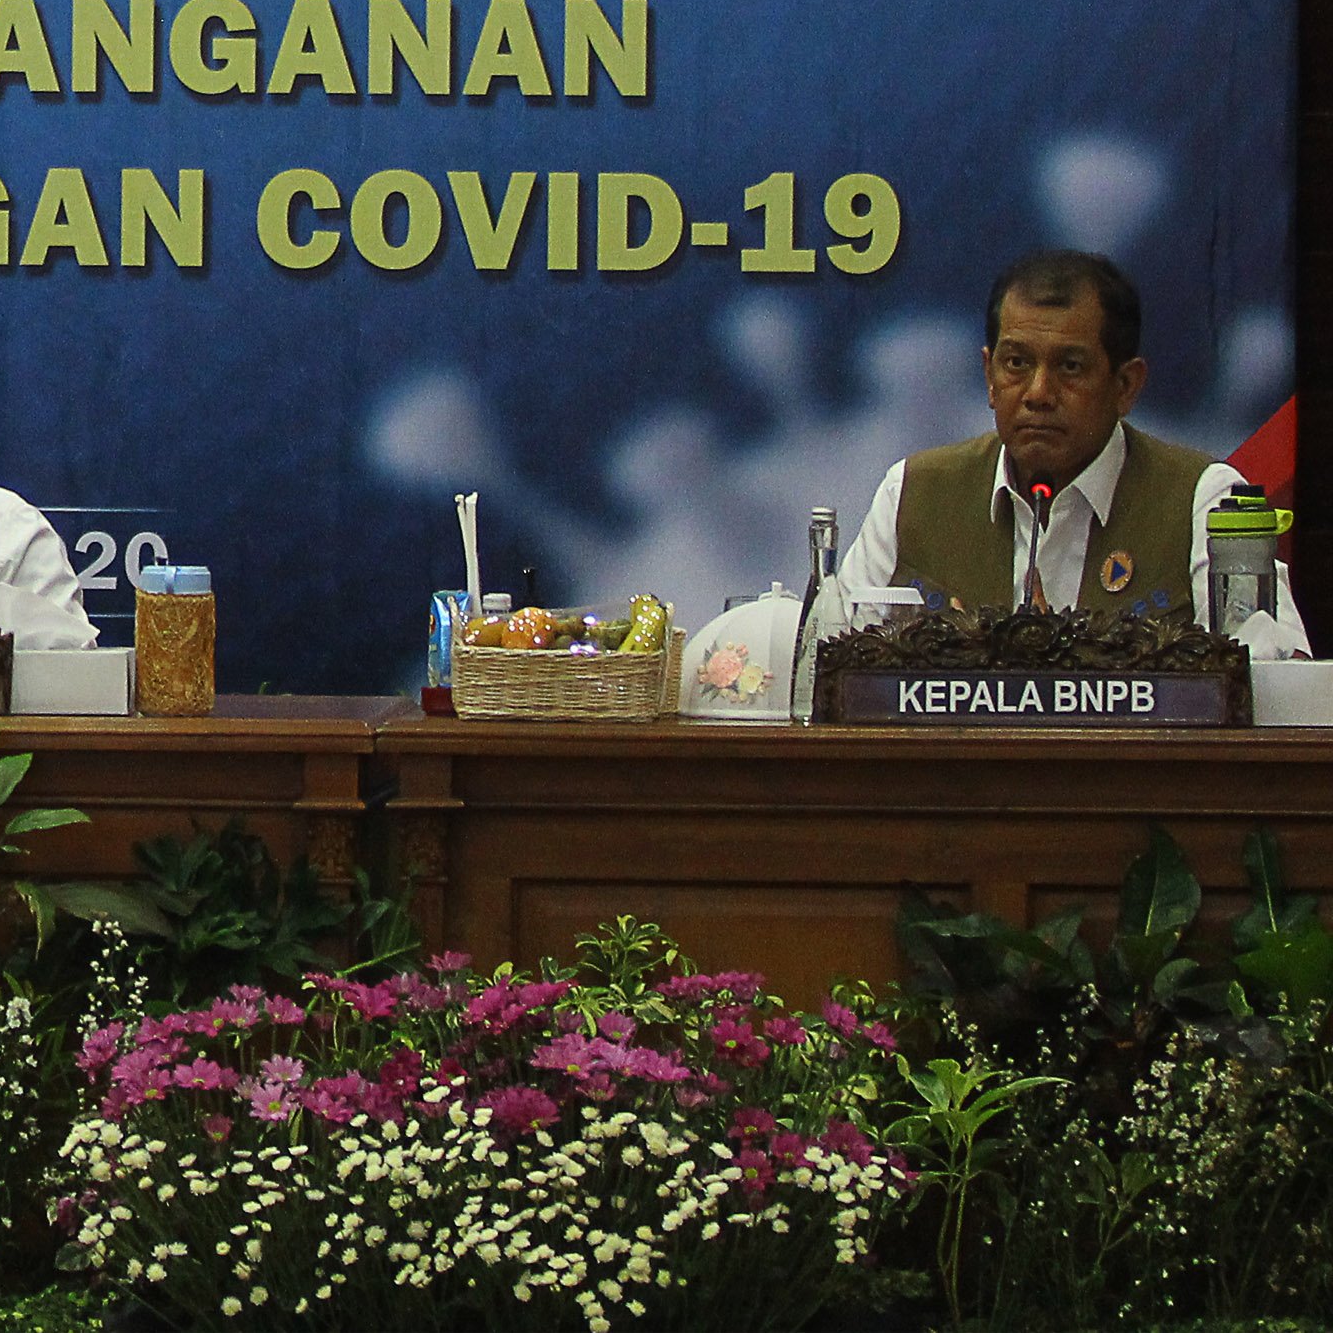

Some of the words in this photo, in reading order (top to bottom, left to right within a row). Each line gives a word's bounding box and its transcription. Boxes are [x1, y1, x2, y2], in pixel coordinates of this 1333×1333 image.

[258, 169, 900, 273] COVID-19
[899, 680, 1044, 713] KEPALA
[1054, 680, 1155, 713] BNPB
